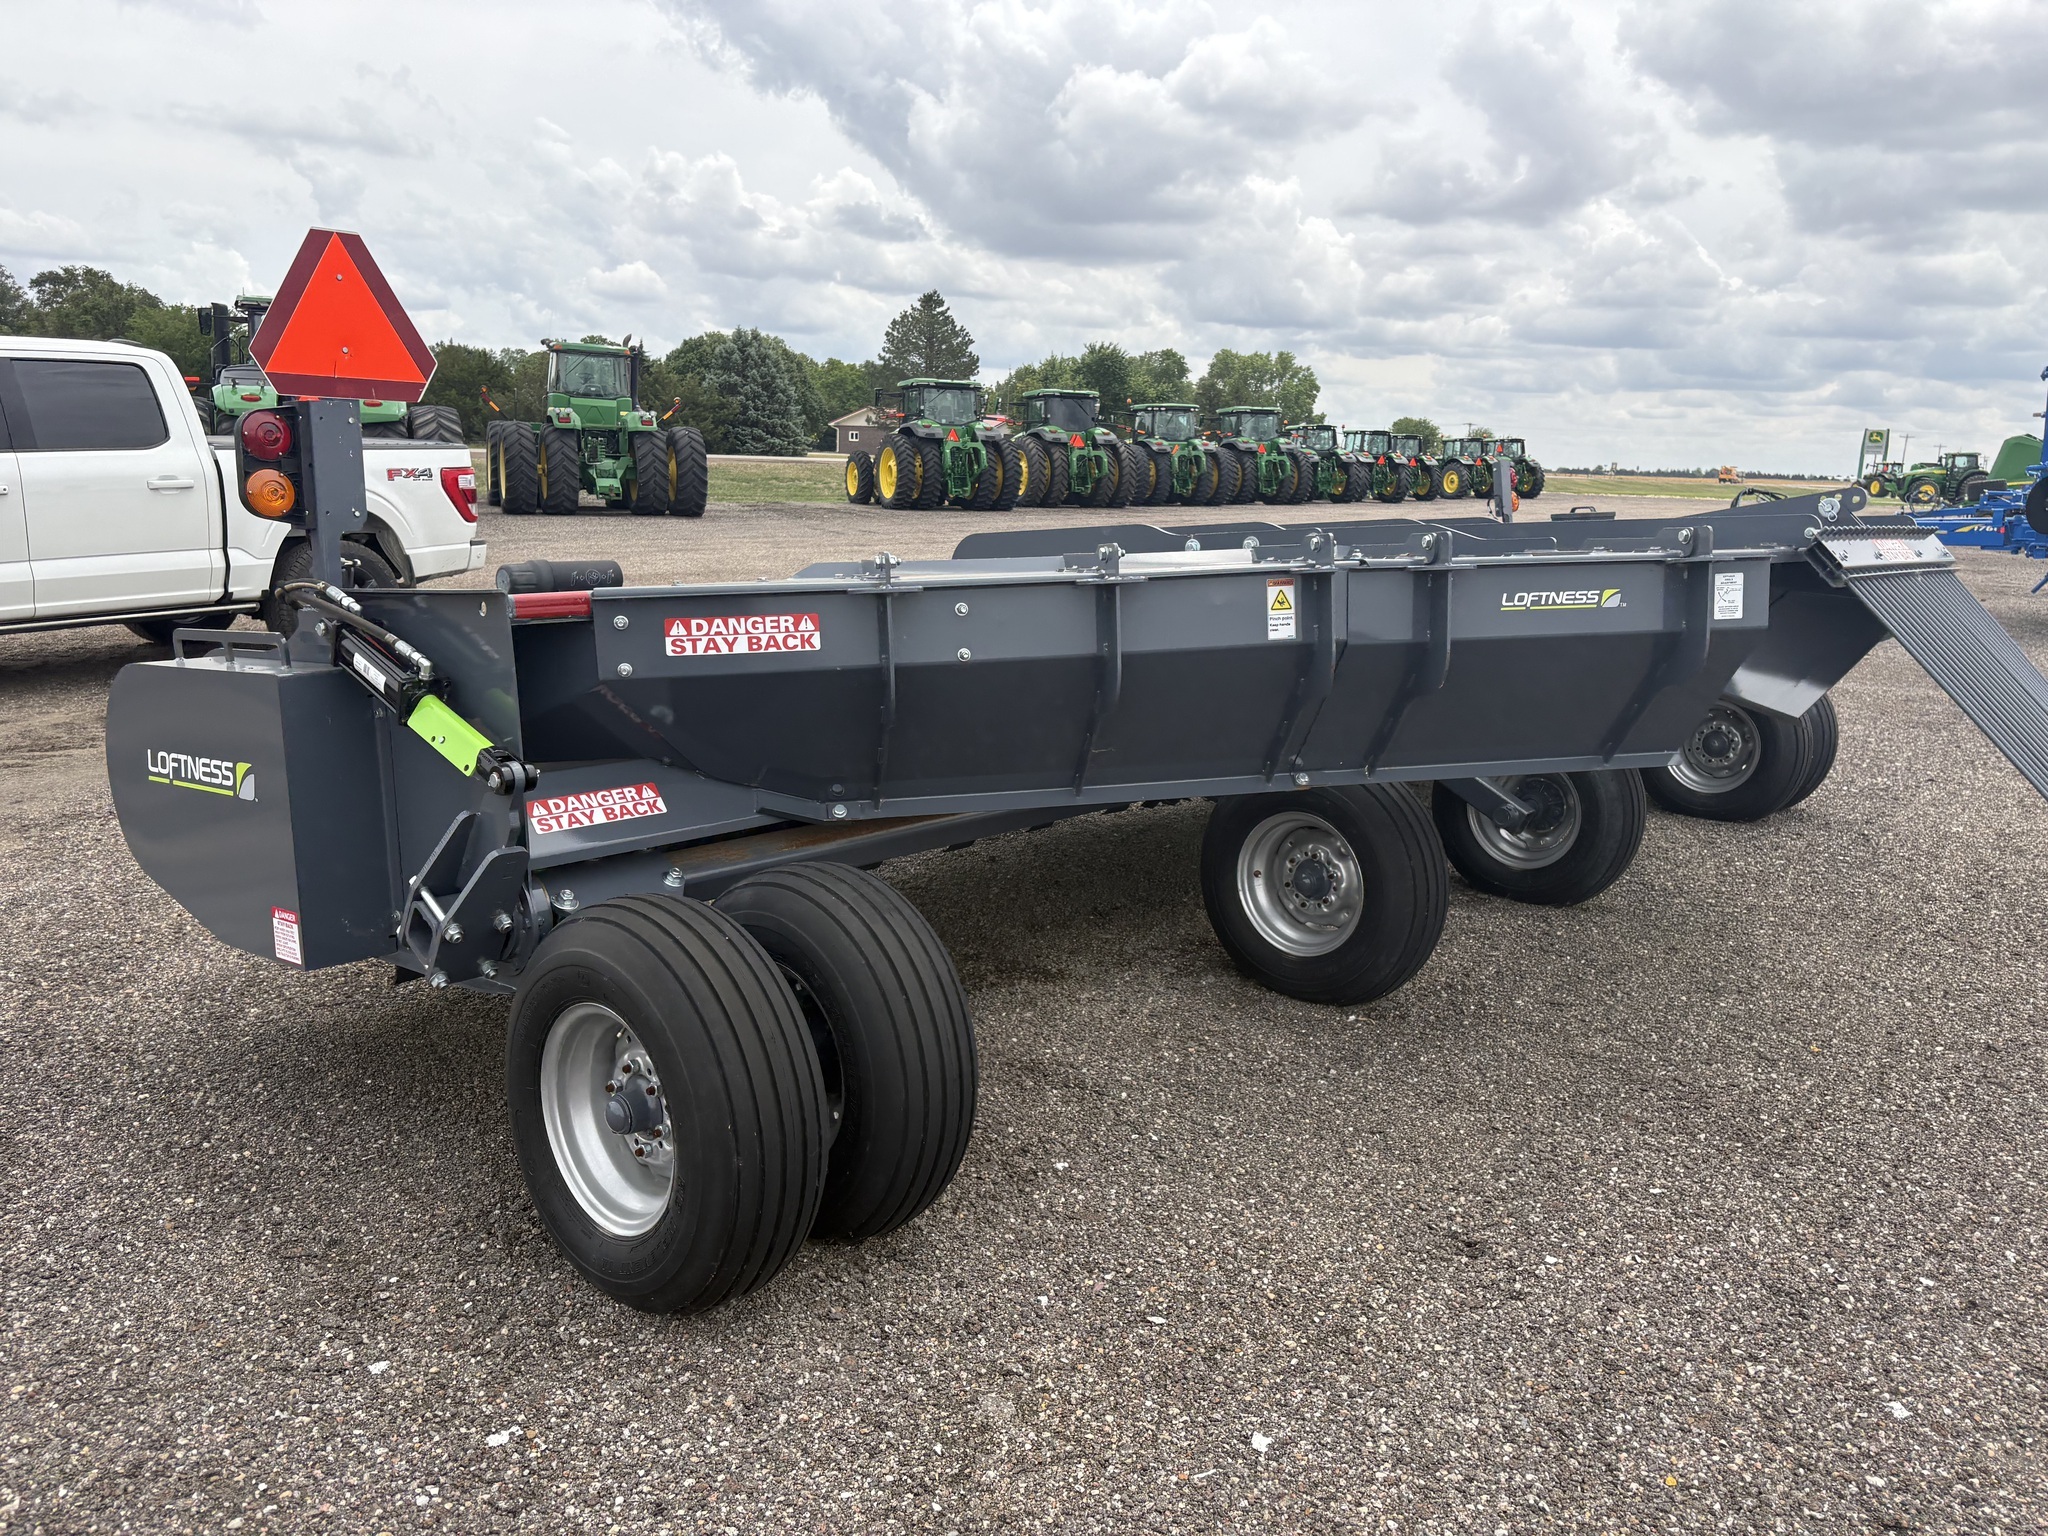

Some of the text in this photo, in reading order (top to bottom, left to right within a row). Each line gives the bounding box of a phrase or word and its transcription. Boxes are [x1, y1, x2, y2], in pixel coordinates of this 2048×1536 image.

[386, 467, 433, 481] FX4
[1501, 590, 1601, 607] LOFTNESS
[690, 615, 795, 636] DANGER
[670, 633, 817, 655] STAY BACK
[147, 748, 234, 787] LOFTNESS
[547, 787, 641, 814] DANGER
[536, 798, 664, 833] STAY BACK
